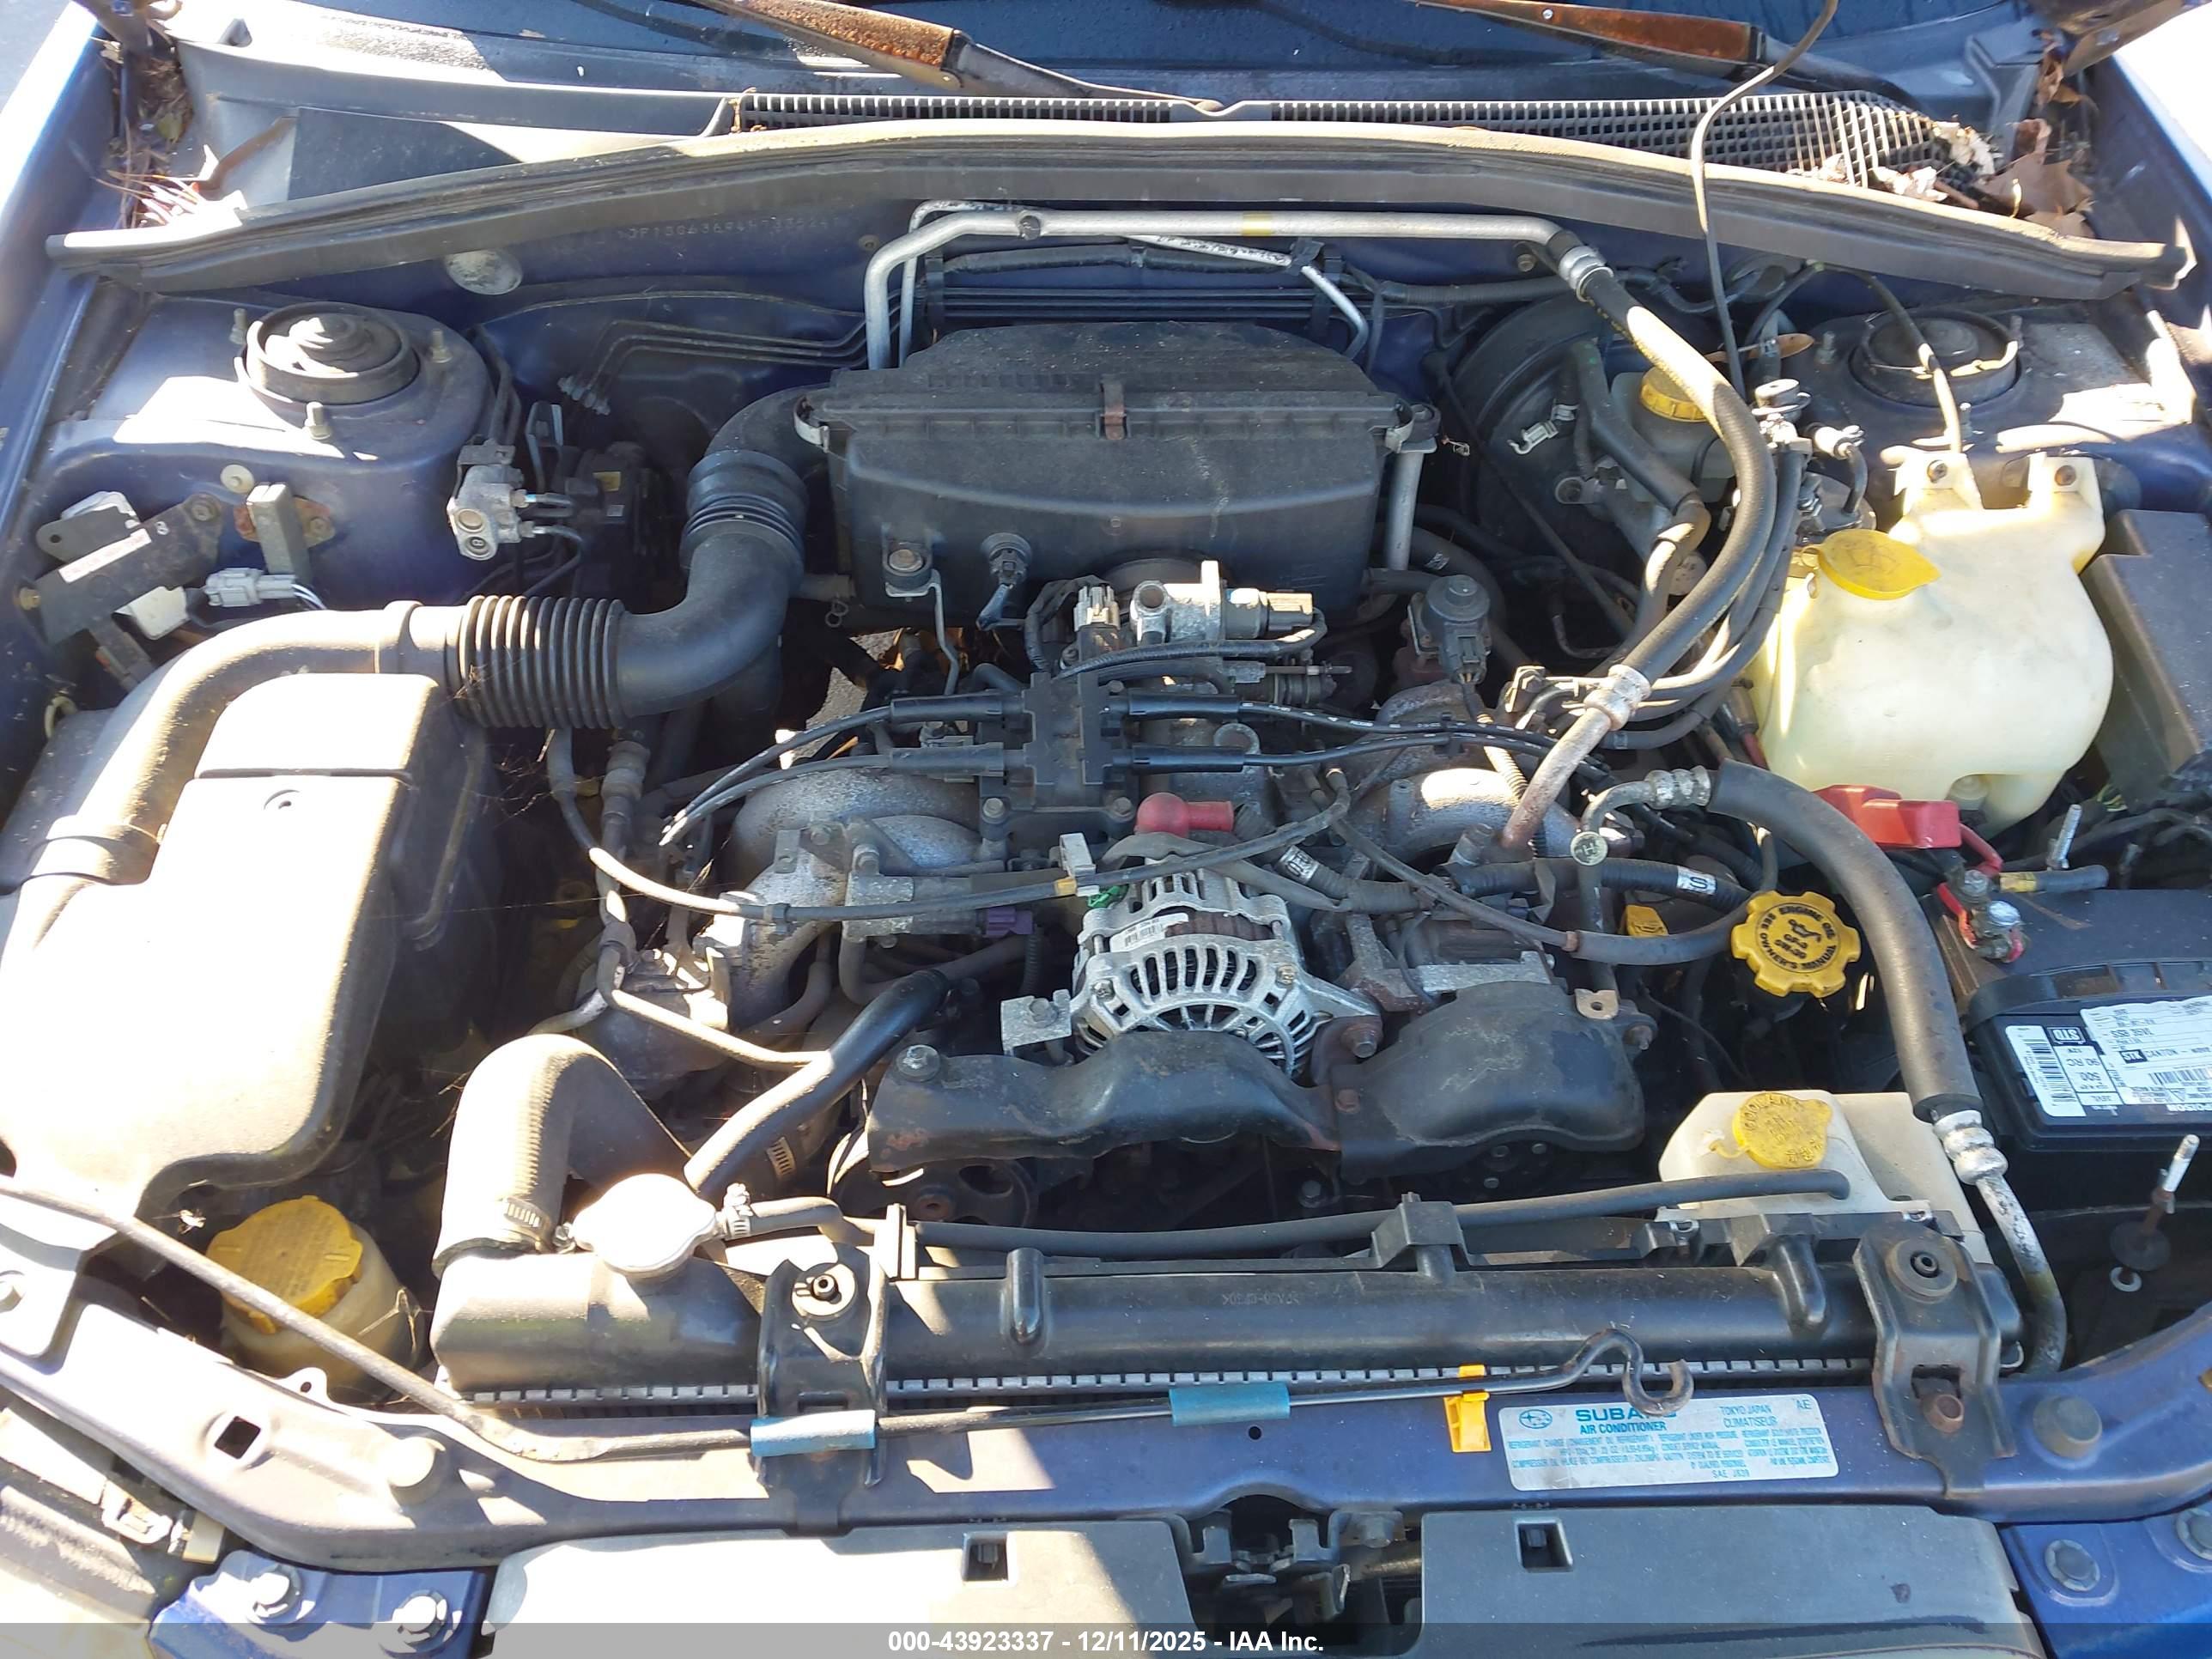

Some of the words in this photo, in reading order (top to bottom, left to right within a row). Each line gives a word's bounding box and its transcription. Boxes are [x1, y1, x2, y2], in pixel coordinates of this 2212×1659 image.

[1779, 906, 1824, 921] ENGINE
[1822, 922, 1835, 940] OIL
[1802, 945, 1837, 970] MANUAL
[1576, 1407, 1676, 1422] SUBA
[1719, 1405, 1746, 1416] TOKYO
[1747, 1405, 1772, 1415] JAPAN
[1580, 1425, 1595, 1435] AIR
[1599, 1421, 1667, 1434] CONDITIONER
